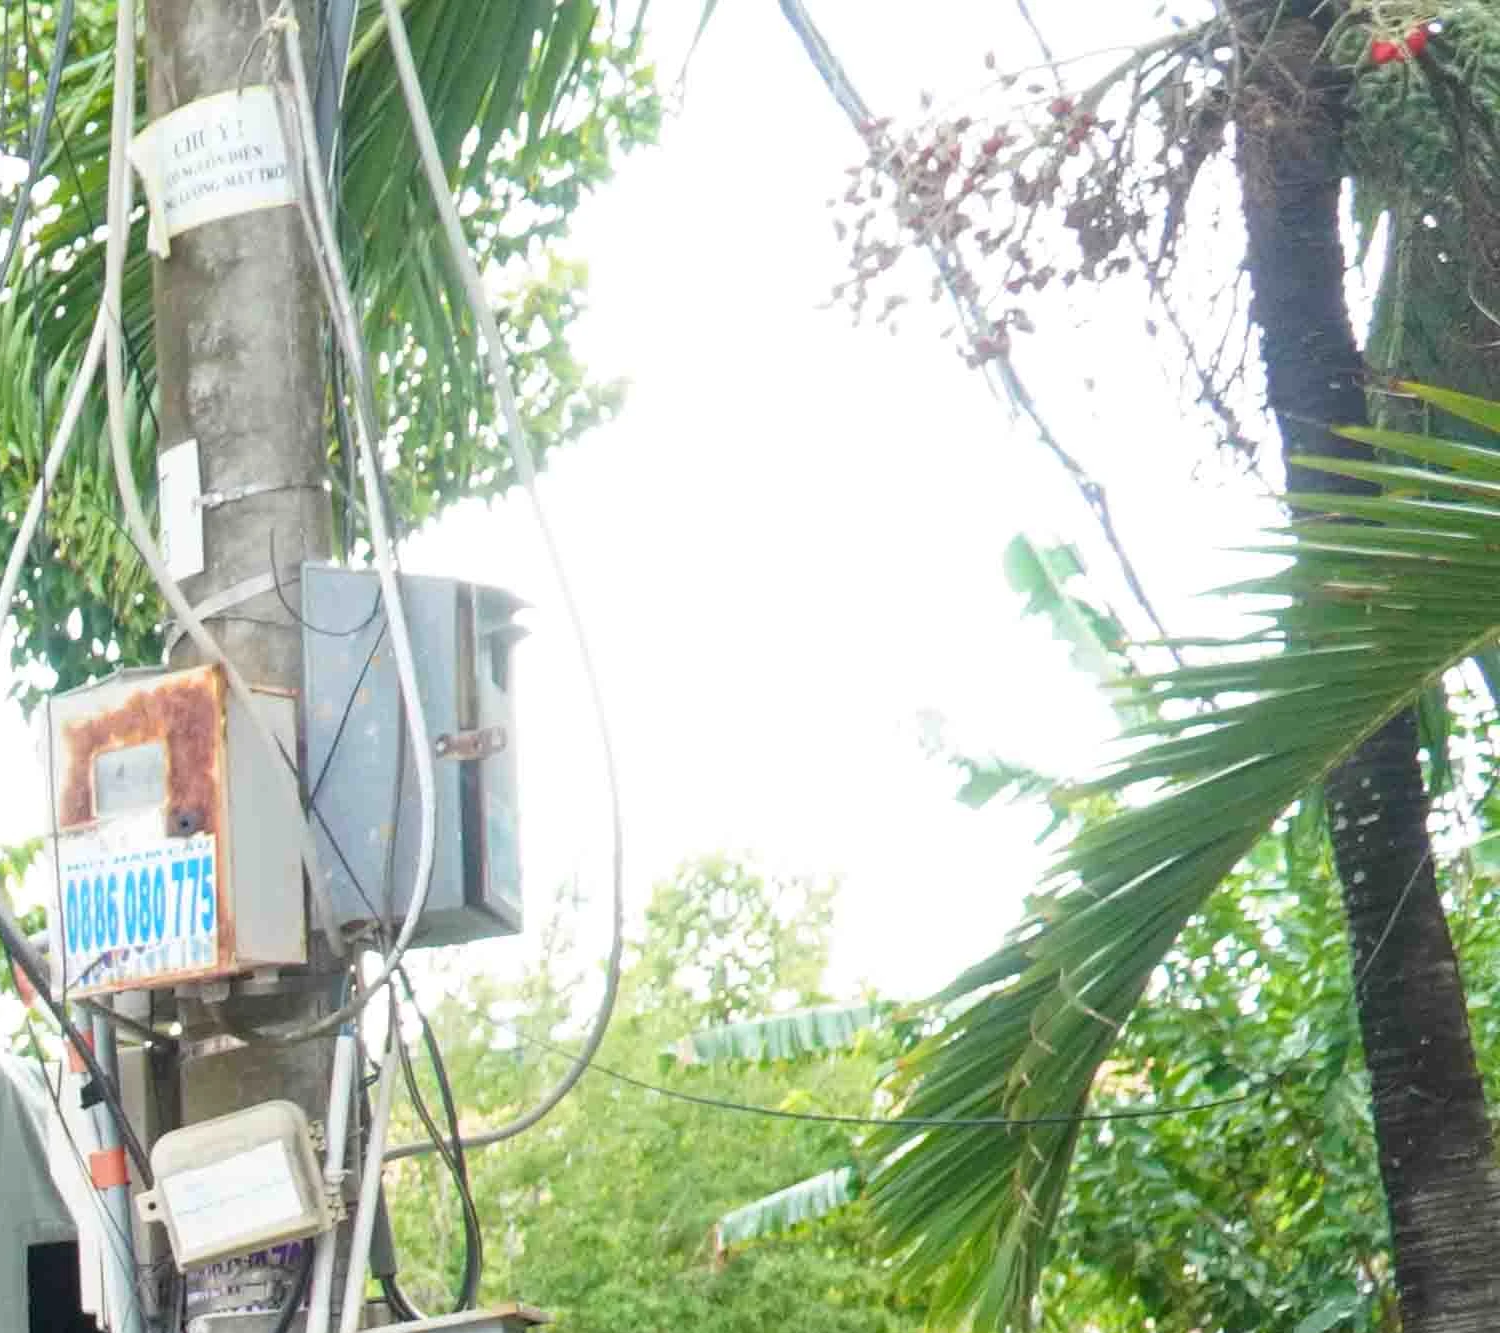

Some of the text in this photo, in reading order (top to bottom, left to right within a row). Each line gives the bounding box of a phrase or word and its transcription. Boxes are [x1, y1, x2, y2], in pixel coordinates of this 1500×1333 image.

[66, 854, 215, 954] 0886 080 775
